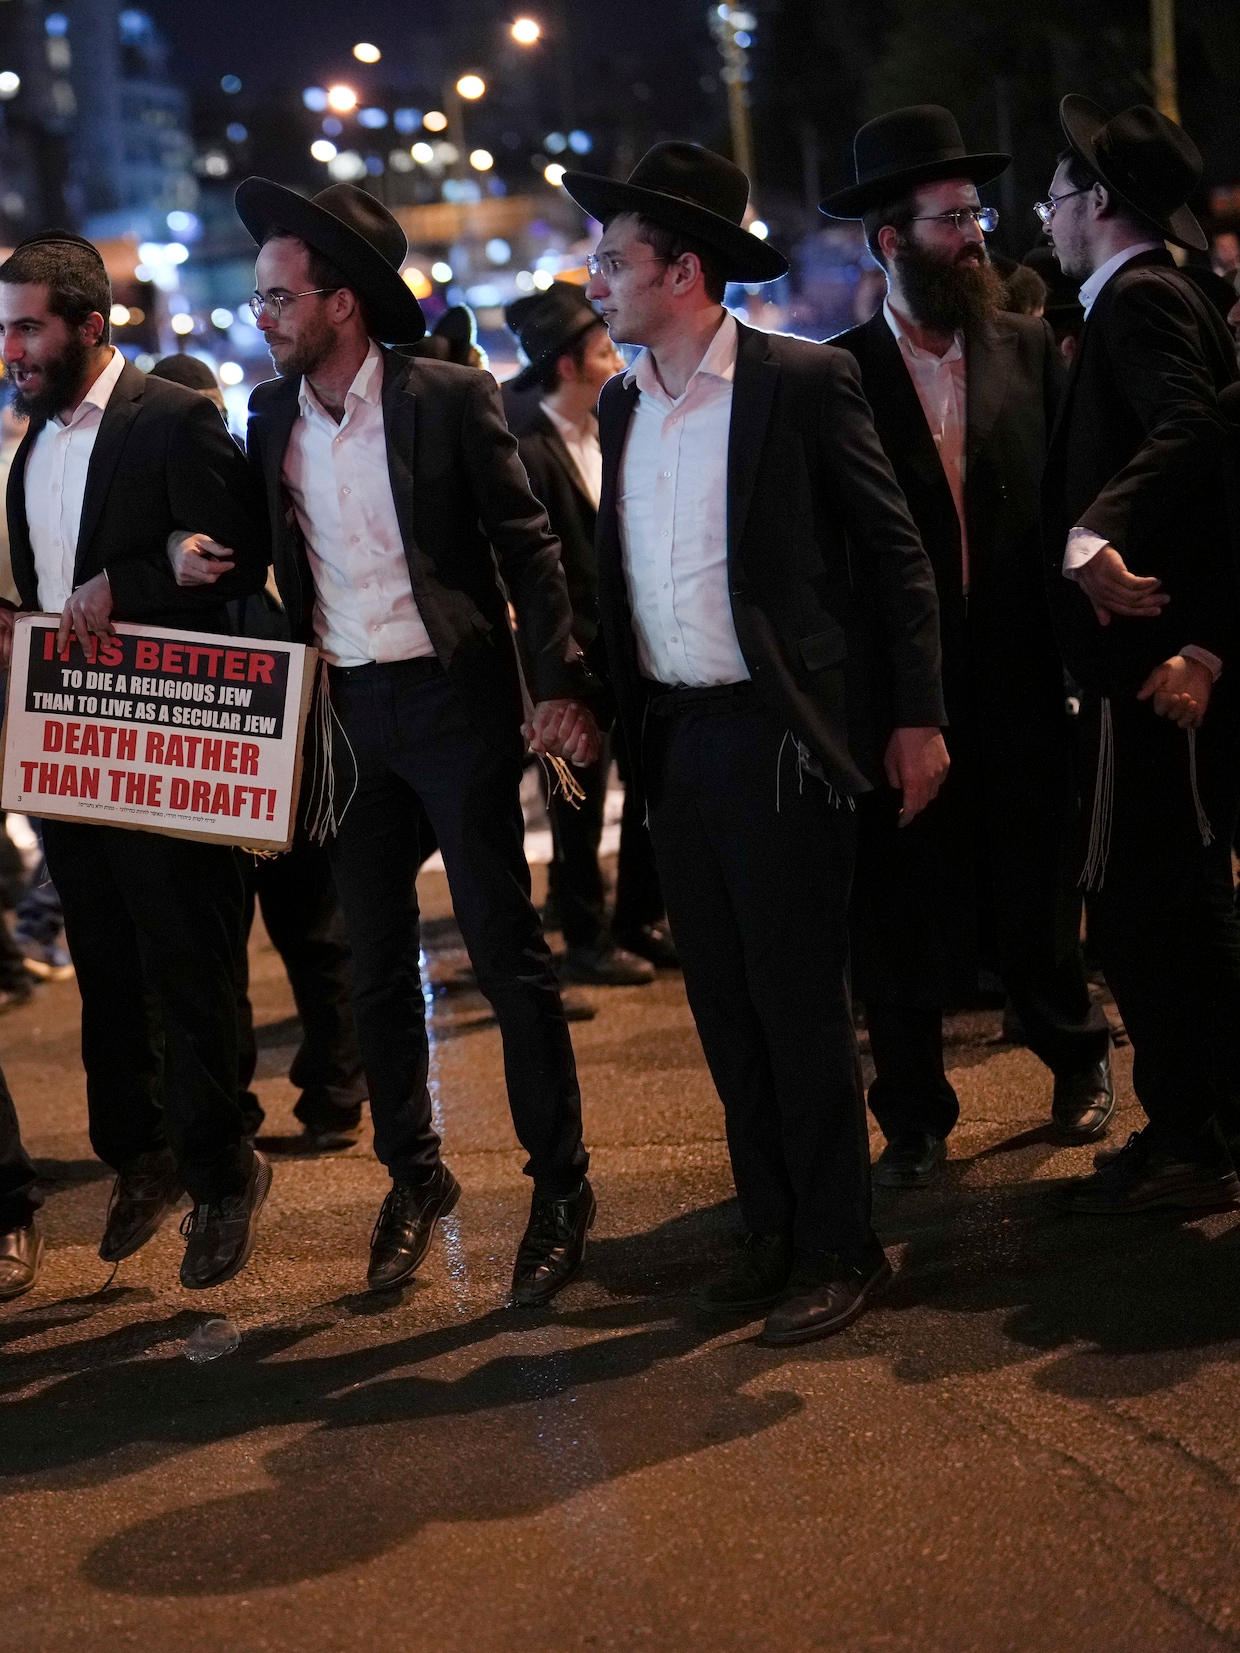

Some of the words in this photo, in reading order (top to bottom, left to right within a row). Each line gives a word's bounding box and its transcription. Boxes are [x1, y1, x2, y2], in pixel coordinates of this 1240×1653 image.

[135, 640, 276, 684] BETTER
[61, 669, 83, 688] TO
[86, 671, 113, 691] DIE
[115, 674, 127, 693] A
[130, 676, 215, 703] RELIGIOUS
[217, 686, 252, 708] JEW
[33, 692, 75, 712] THAN
[77, 696, 98, 714] TO
[100, 698, 133, 718] LIVE
[134, 702, 156, 722] AS
[158, 704, 170, 723] A
[172, 706, 241, 731] SECULAR
[243, 715, 277, 735] JEW
[43, 720, 139, 761] DEATH
[145, 731, 261, 776] RATHER
[20, 761, 101, 799] THAN
[108, 769, 164, 808] THE
[169, 777, 278, 821] DRAFT!
